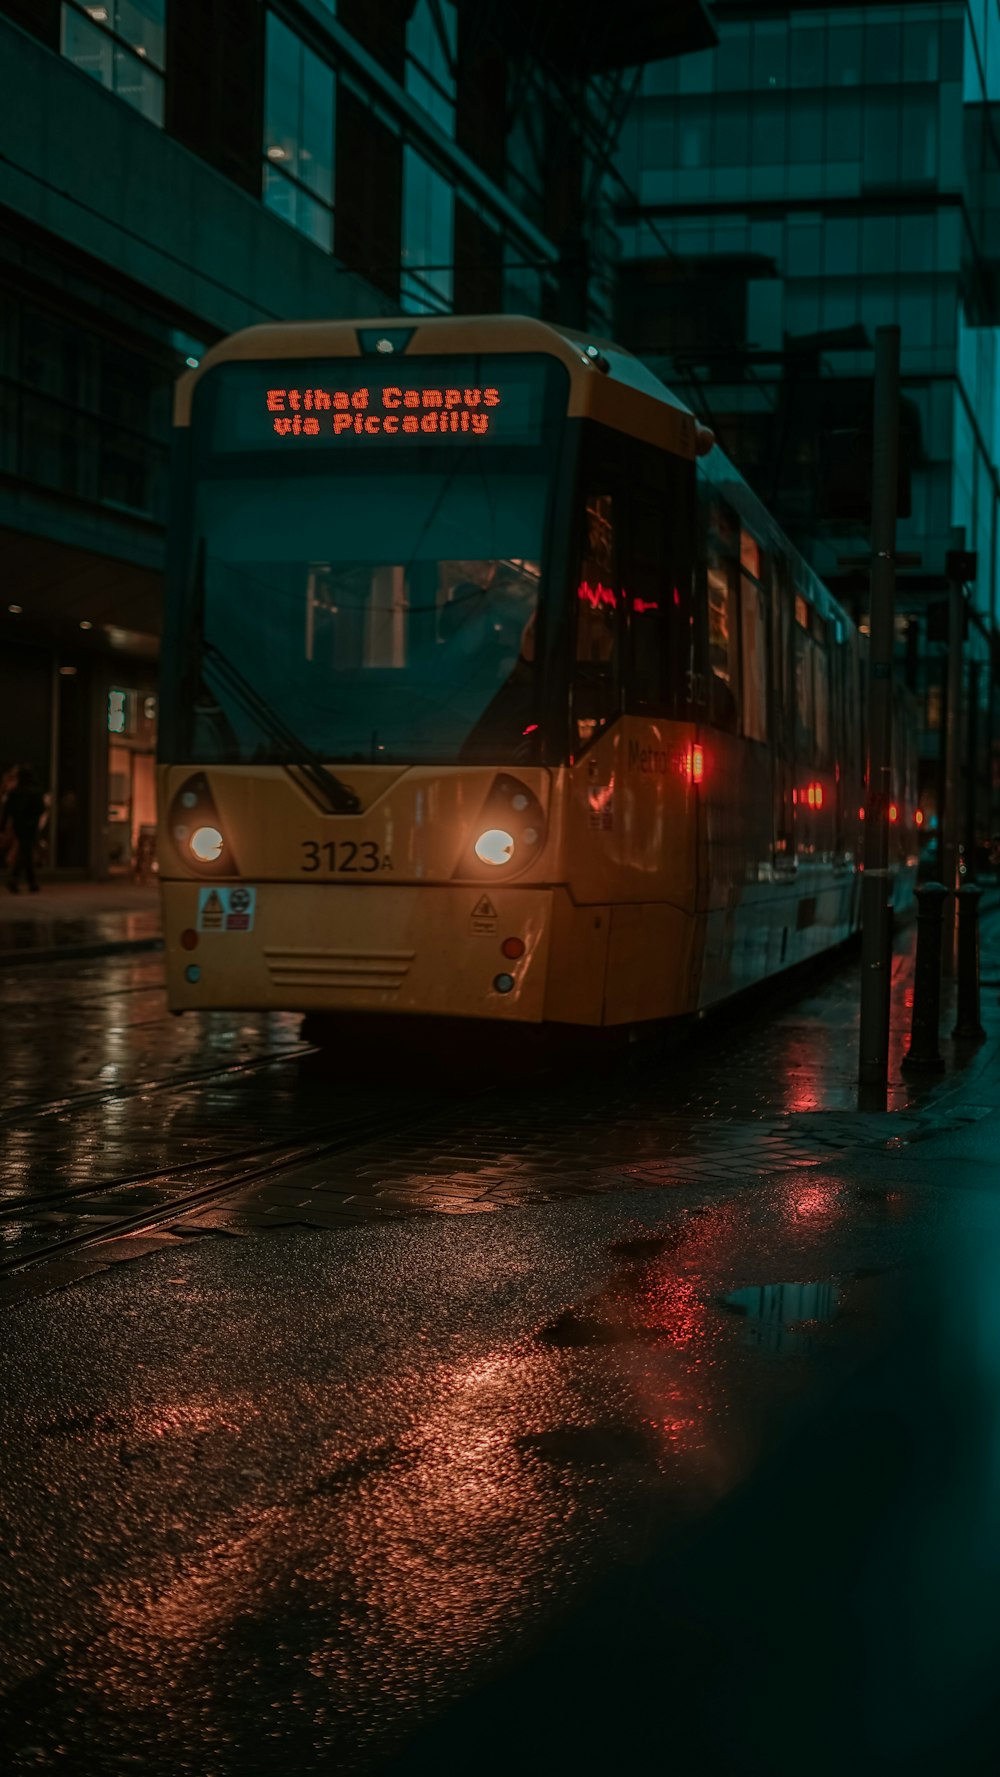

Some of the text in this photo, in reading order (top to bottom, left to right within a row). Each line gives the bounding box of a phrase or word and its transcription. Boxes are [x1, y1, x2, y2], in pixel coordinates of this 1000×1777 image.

[266, 386, 501, 411] Etihad Campus
[273, 411, 490, 436] via Piccadilly
